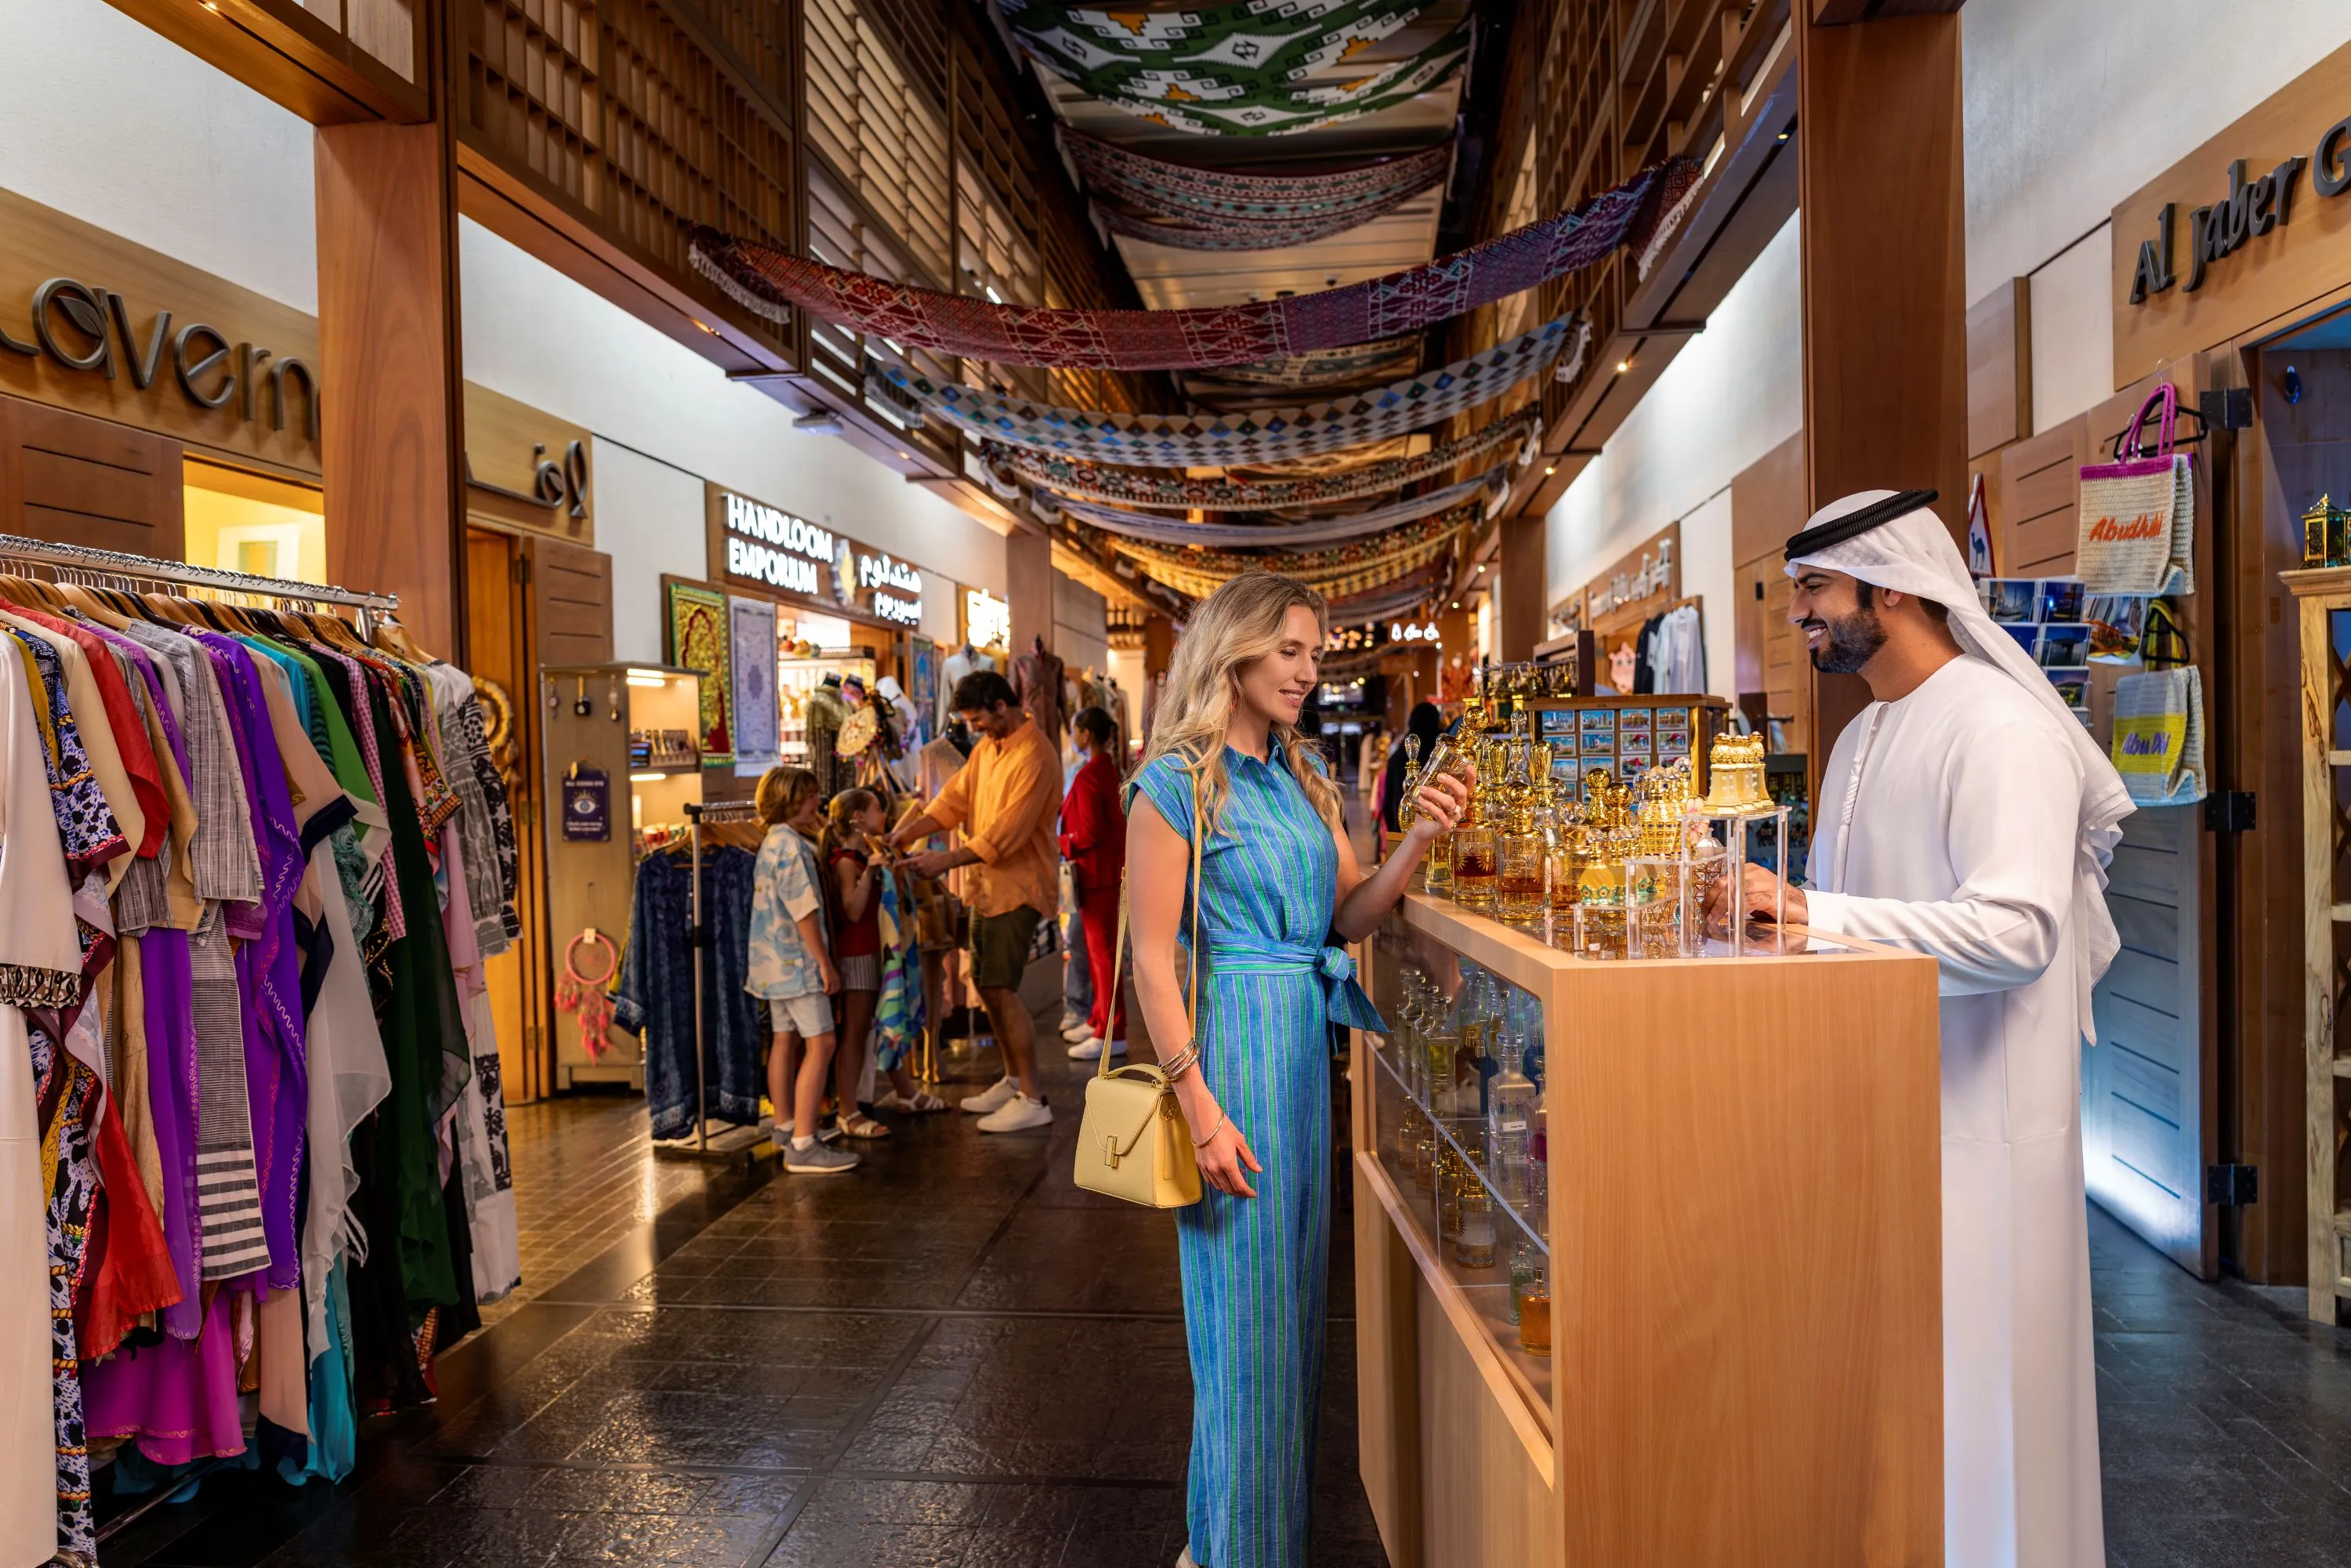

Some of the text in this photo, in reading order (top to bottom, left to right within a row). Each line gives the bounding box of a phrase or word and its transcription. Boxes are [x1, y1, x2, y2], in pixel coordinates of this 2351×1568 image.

[2129, 203, 2176, 305] Al
[2182, 156, 2308, 293] Jaber
[727, 493, 833, 563] HANDLOOM
[729, 537, 818, 595] EMPORIUM
